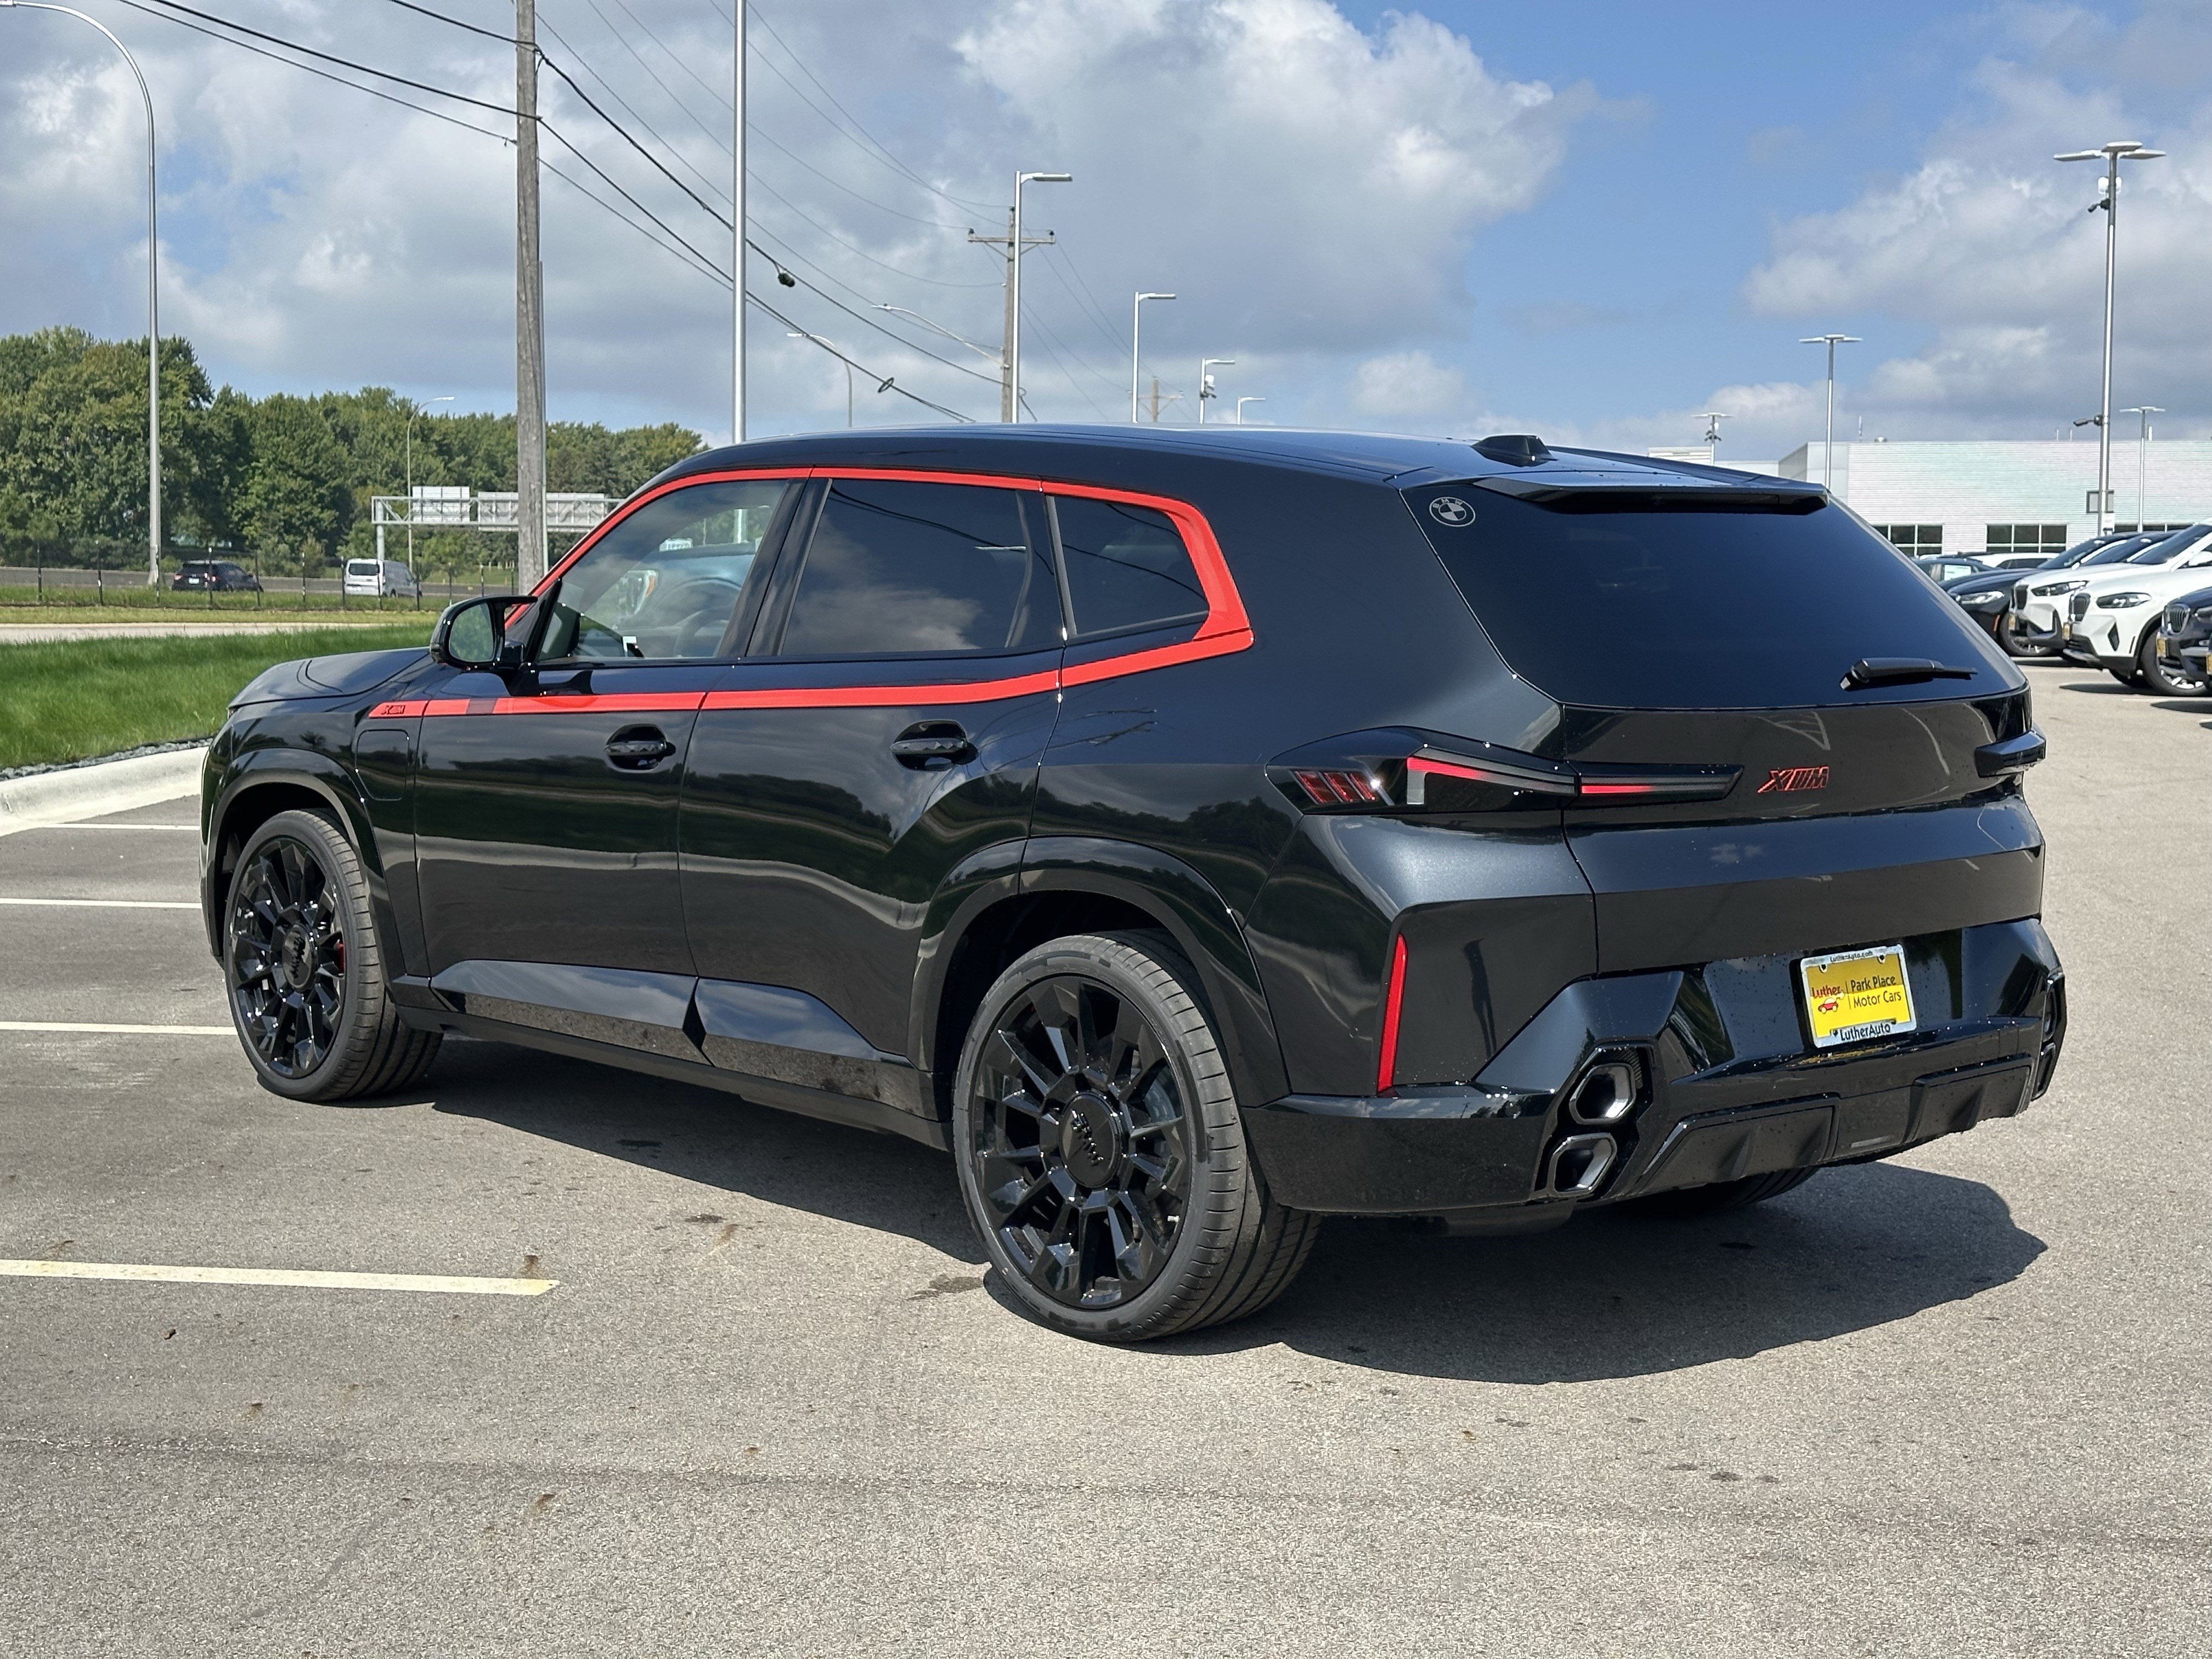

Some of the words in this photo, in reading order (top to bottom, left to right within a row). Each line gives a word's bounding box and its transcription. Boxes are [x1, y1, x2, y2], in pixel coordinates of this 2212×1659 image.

[1812, 985, 1841, 998] Luther
[1850, 978, 1870, 992] Park
[1872, 975, 1896, 988] Place
[1853, 995, 1880, 1008] Motor
[1883, 990, 1901, 1003] Cars
[1839, 1023, 1891, 1041] LutherAuto
